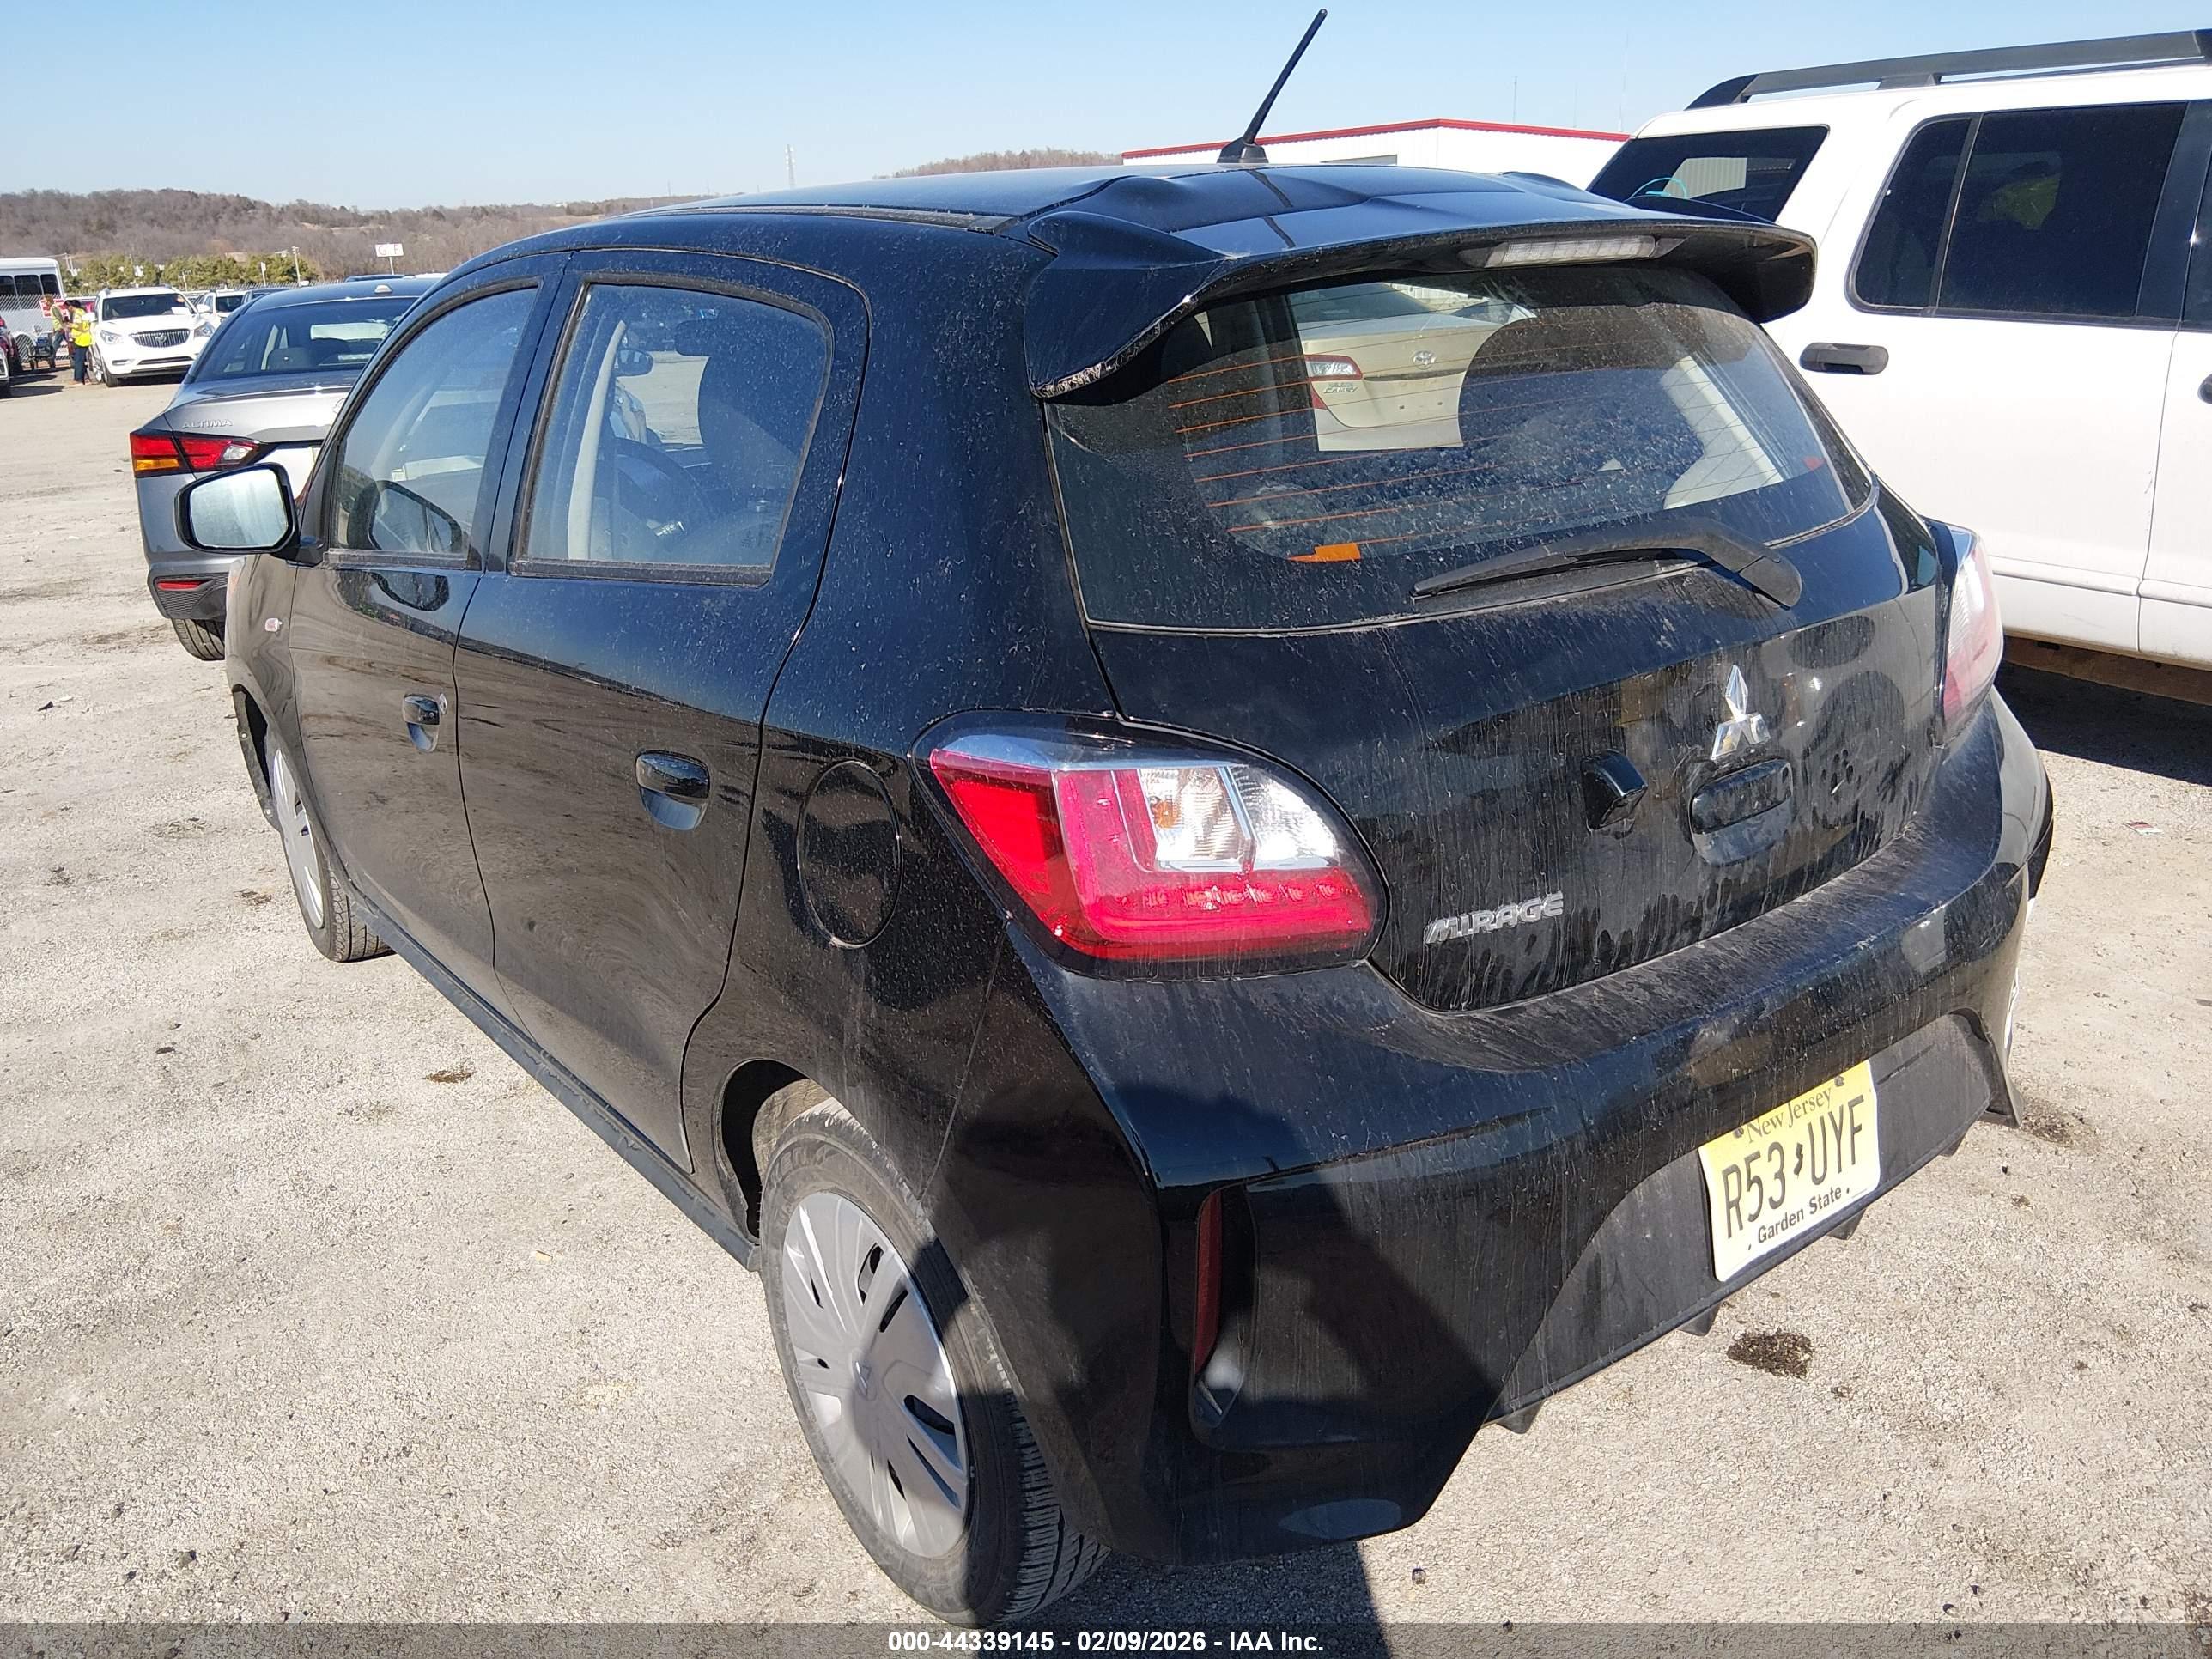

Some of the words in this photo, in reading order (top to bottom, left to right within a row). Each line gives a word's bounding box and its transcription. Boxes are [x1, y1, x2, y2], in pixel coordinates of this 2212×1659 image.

[181, 418, 234, 429] ALTIMA
[1424, 890, 1564, 944] MIRAGE
[1747, 1114, 1784, 1143] New
[1787, 1088, 1832, 1127] Jersey
[1758, 1208, 1804, 1243] Garden
[1808, 1186, 1842, 1215] State
